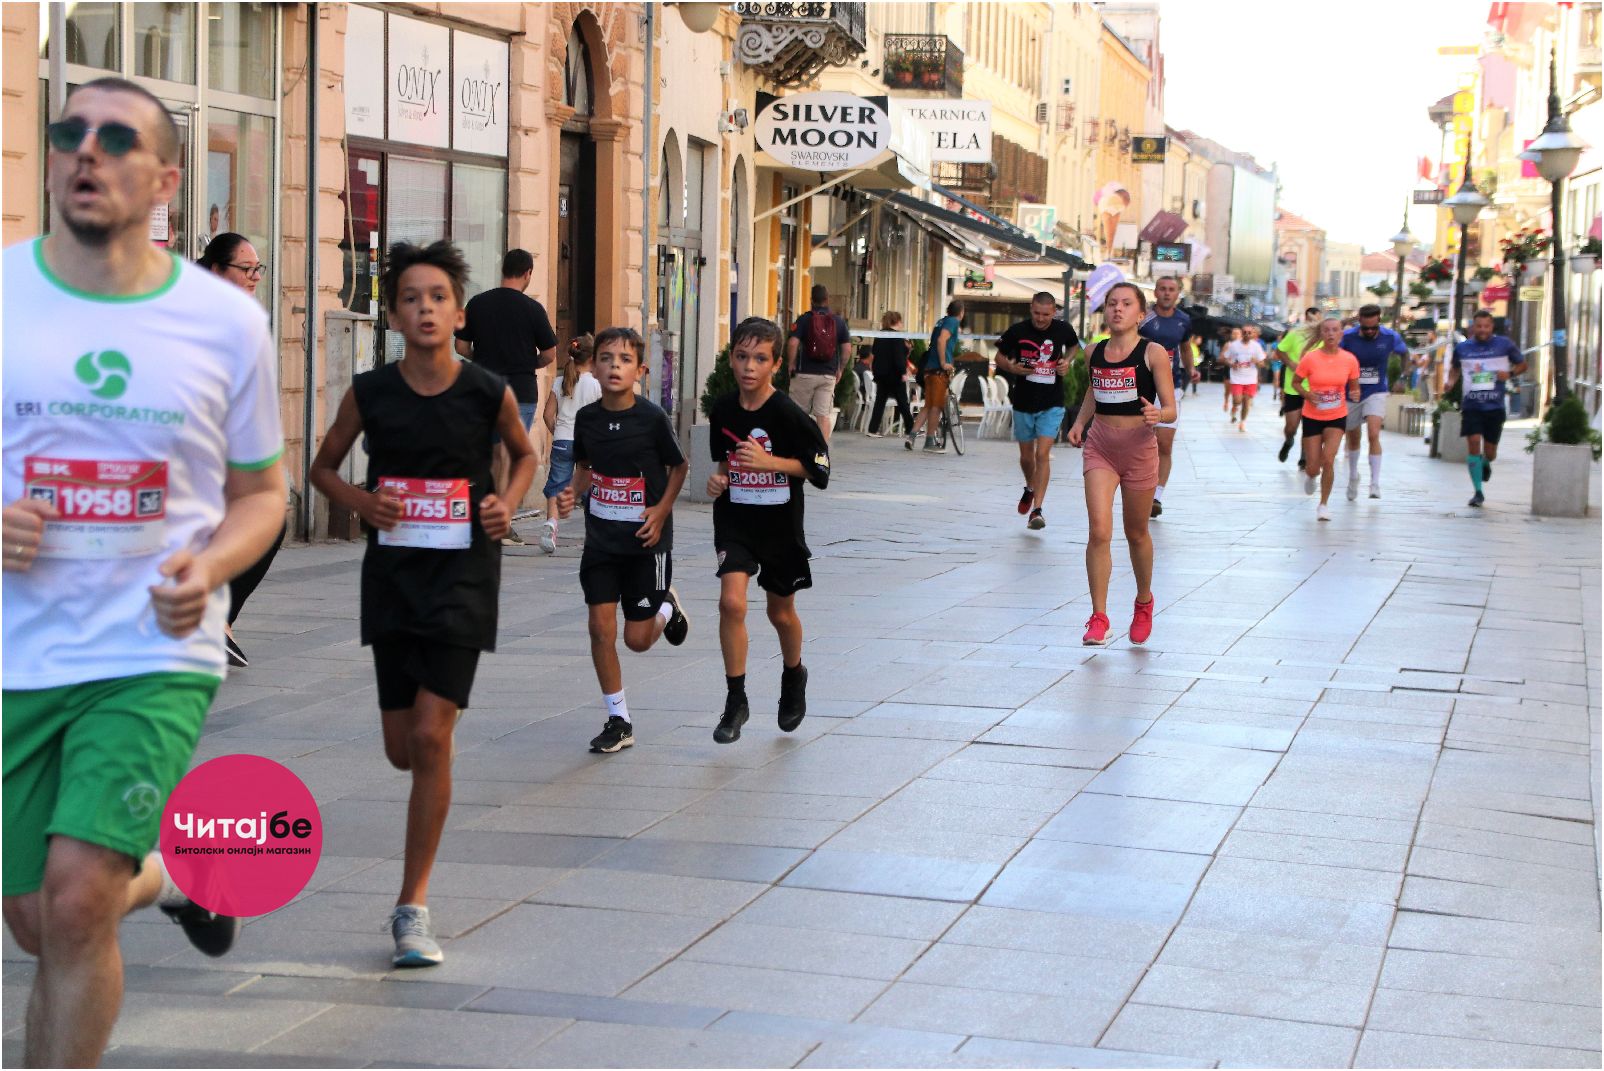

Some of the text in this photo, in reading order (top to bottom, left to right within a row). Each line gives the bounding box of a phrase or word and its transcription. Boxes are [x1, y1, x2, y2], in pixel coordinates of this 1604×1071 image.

[398, 64, 441, 117] ONIX
[461, 77, 501, 127] ONIX
[772, 103, 877, 125] SILVER
[771, 127, 878, 149] MOON
[930, 131, 982, 150] ELA
[790, 151, 849, 162] SWAROVSKI
[1100, 378, 1124, 388] 1826
[16, 402, 186, 425] ERI CORPORATION
[740, 472, 773, 485] 2081
[61, 488, 132, 517] 1958
[600, 487, 628, 502] 1782
[404, 498, 447, 519] 1755
